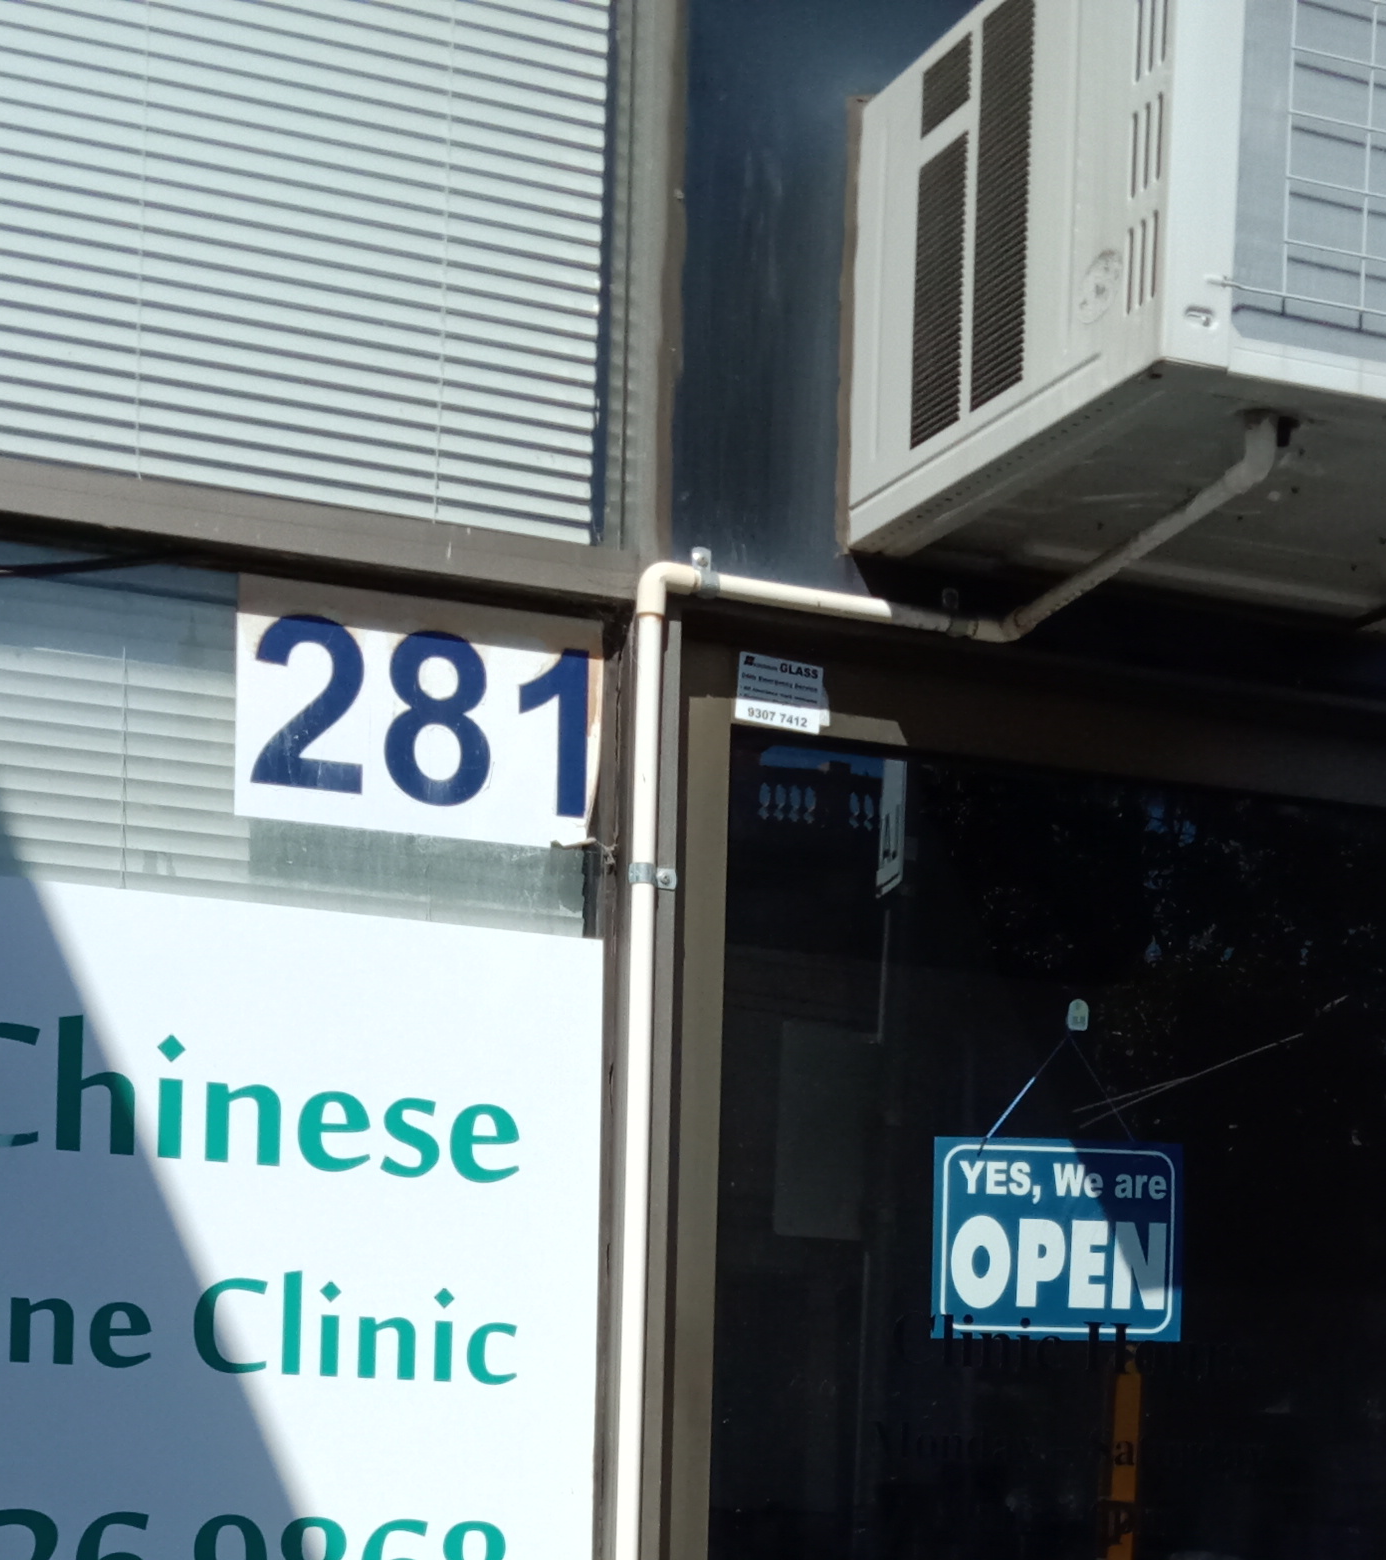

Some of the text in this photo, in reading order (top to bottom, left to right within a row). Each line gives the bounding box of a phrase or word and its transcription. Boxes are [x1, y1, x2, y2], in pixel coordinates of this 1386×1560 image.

[780, 663, 818, 679] GLASS
[250, 613, 590, 819] 281
[747, 707, 808, 728] 9307 7412
[959, 1160, 1168, 1204] YES, We are
[950, 1214, 1168, 1311] OPEN
[193, 1271, 518, 1386] Clinic
